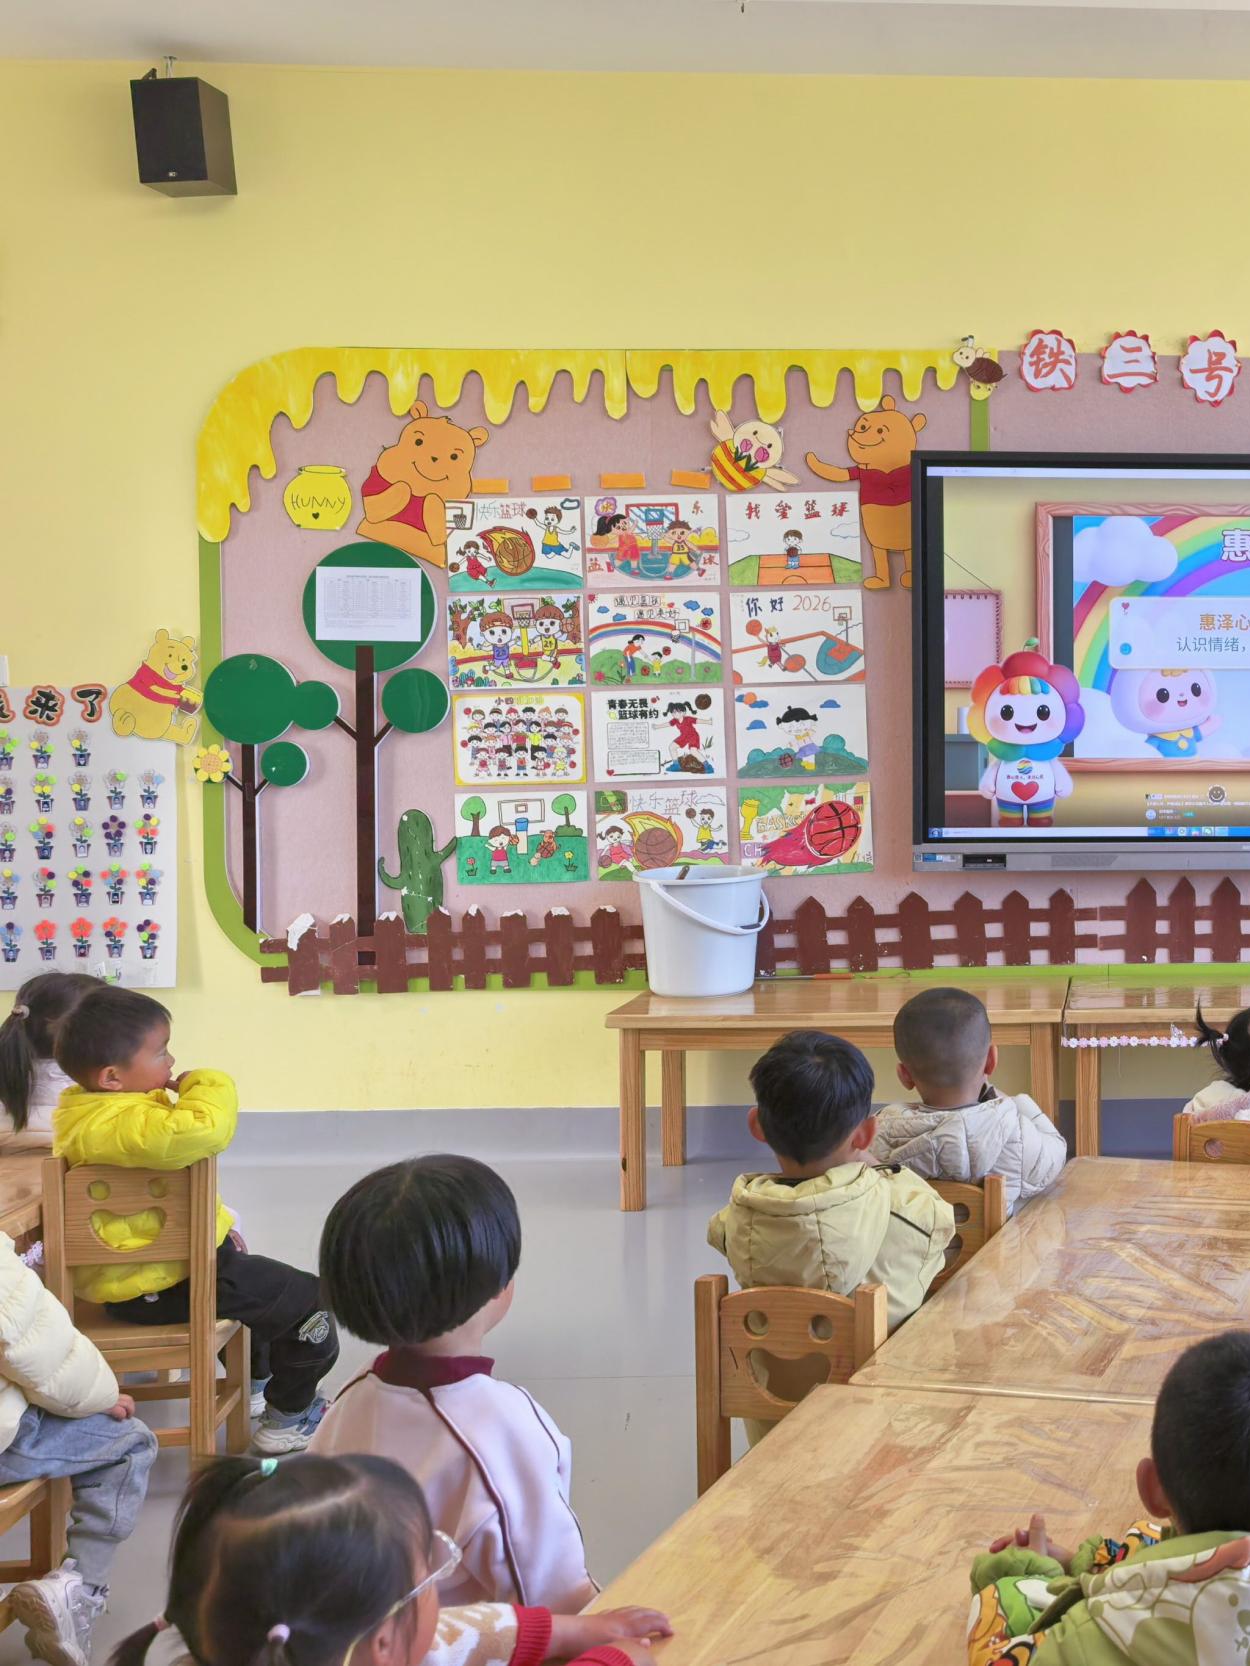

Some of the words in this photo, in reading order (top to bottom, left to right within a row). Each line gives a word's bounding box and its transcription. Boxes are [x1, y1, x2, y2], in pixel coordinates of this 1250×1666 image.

[290, 492, 346, 514] HUNNY
[745, 499, 850, 520] 我爱篮球
[746, 597, 784, 618] 你好
[792, 594, 832, 612] 2026
[607, 698, 649, 710] 青春无畏
[618, 708, 659, 720] 篮球有约
